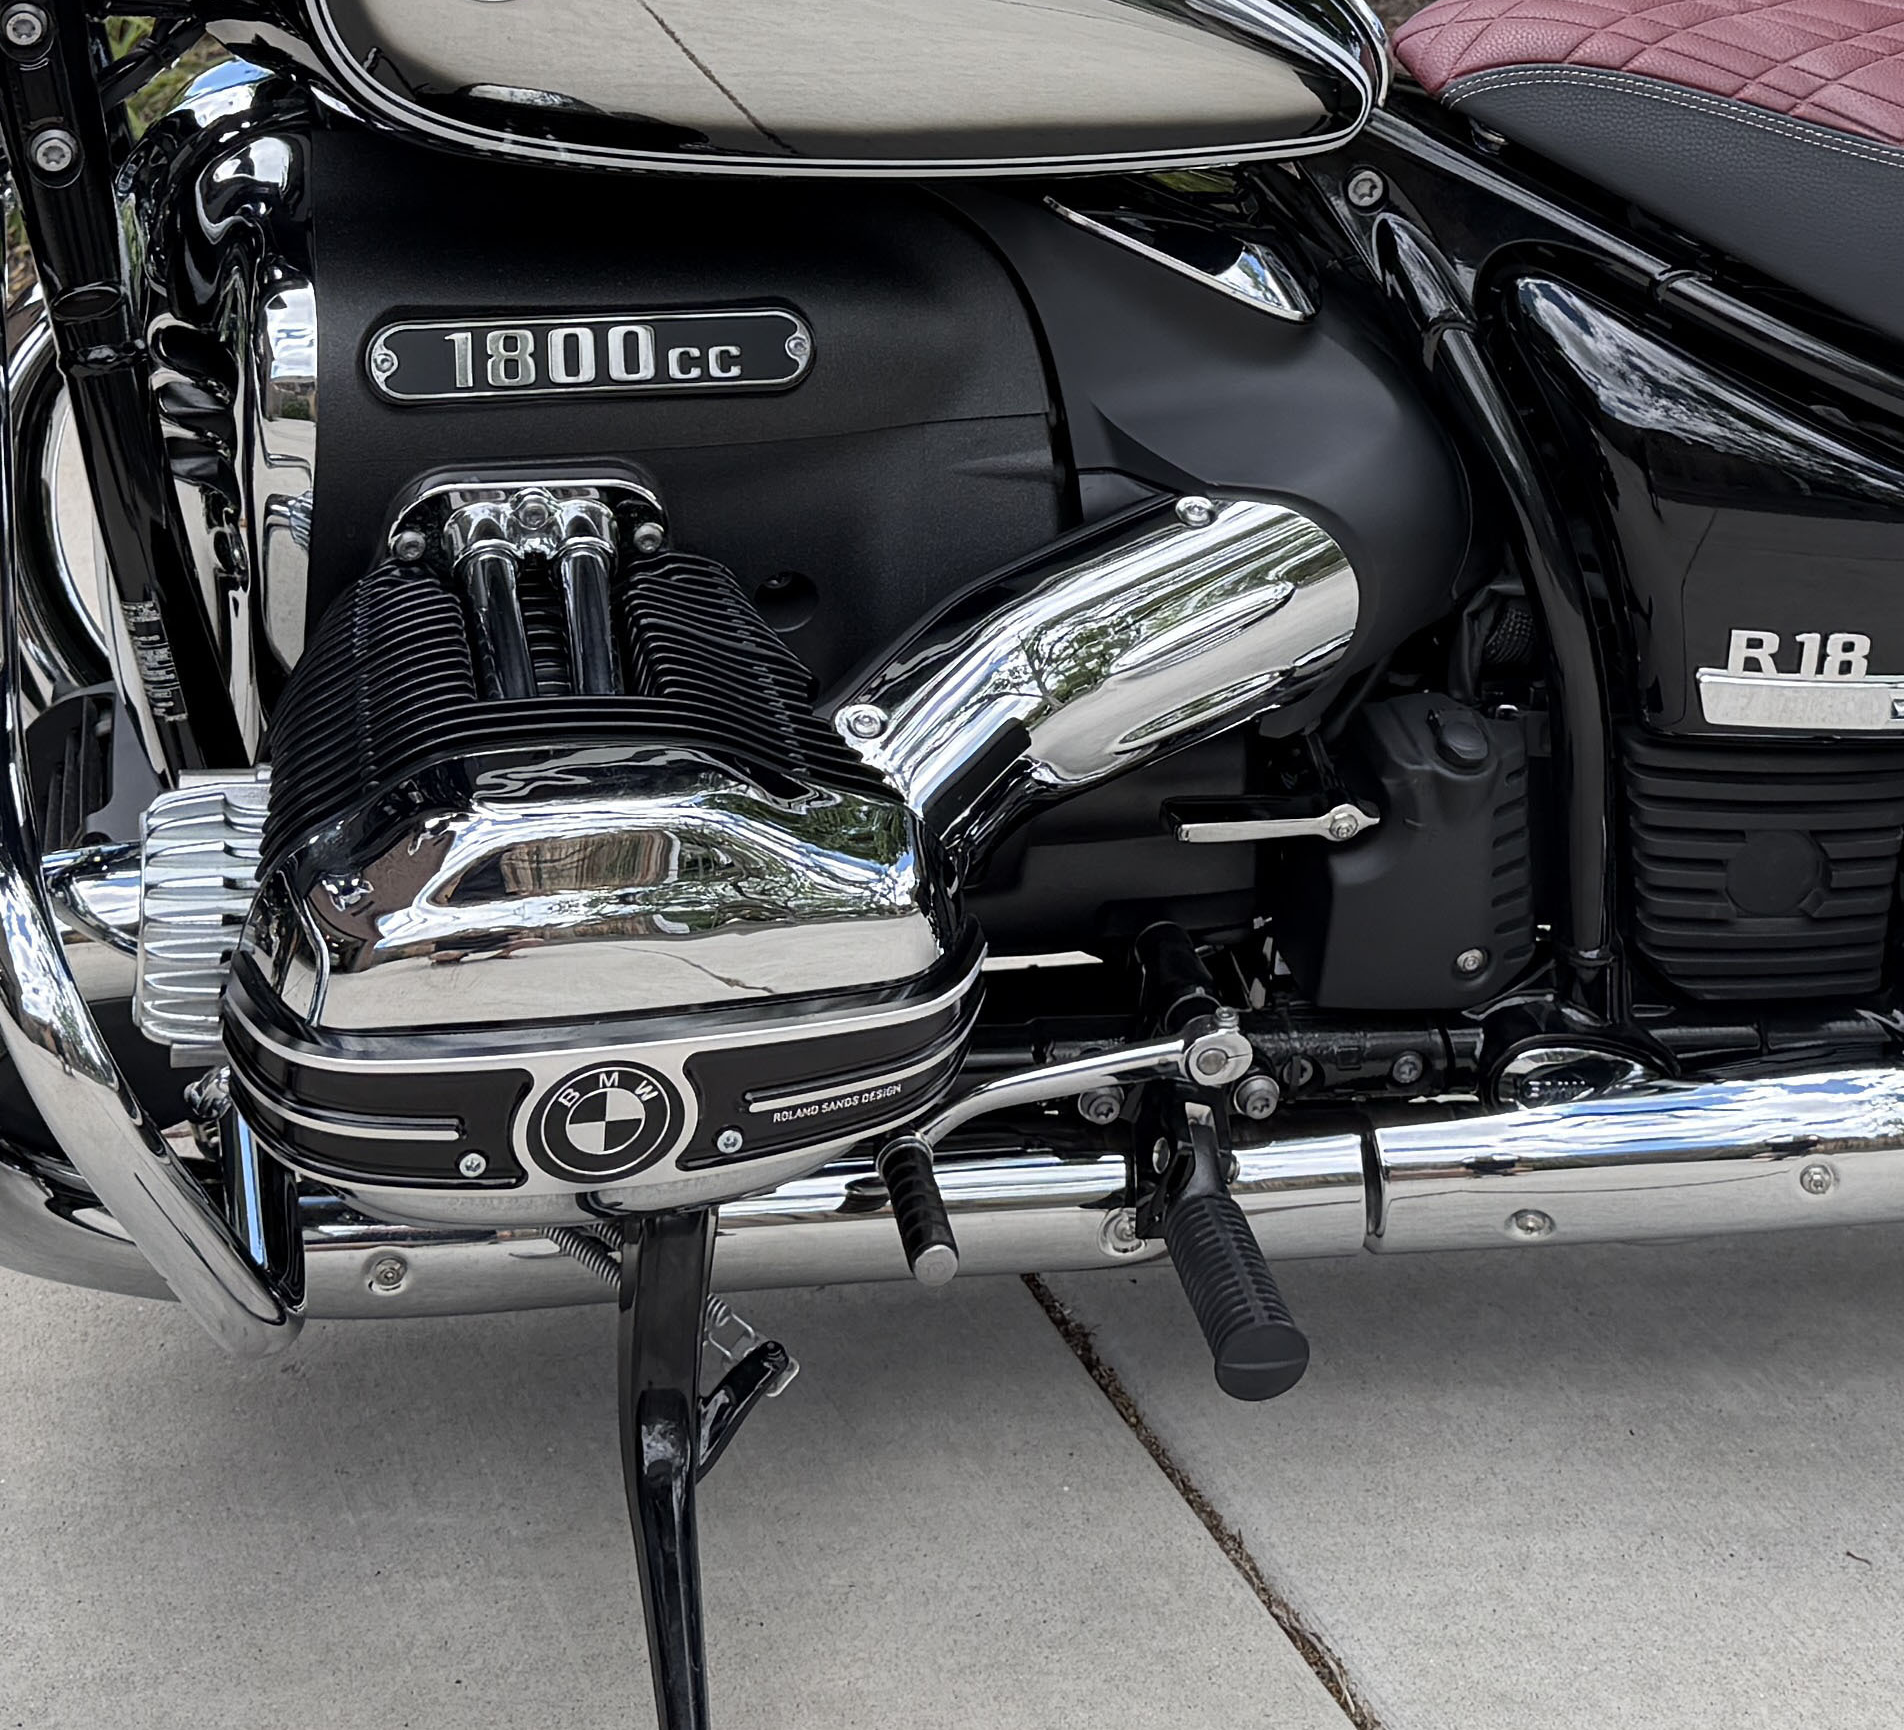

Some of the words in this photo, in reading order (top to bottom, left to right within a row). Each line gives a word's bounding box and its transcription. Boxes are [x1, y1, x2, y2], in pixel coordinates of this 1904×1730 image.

[1727, 629, 1780, 676] R
[1795, 631, 1871, 679] 18
[557, 1071, 659, 1109] BMW
[772, 1105, 819, 1123] ROLAND
[821, 1095, 860, 1114] SANDS
[861, 1083, 902, 1104] DESIGN
